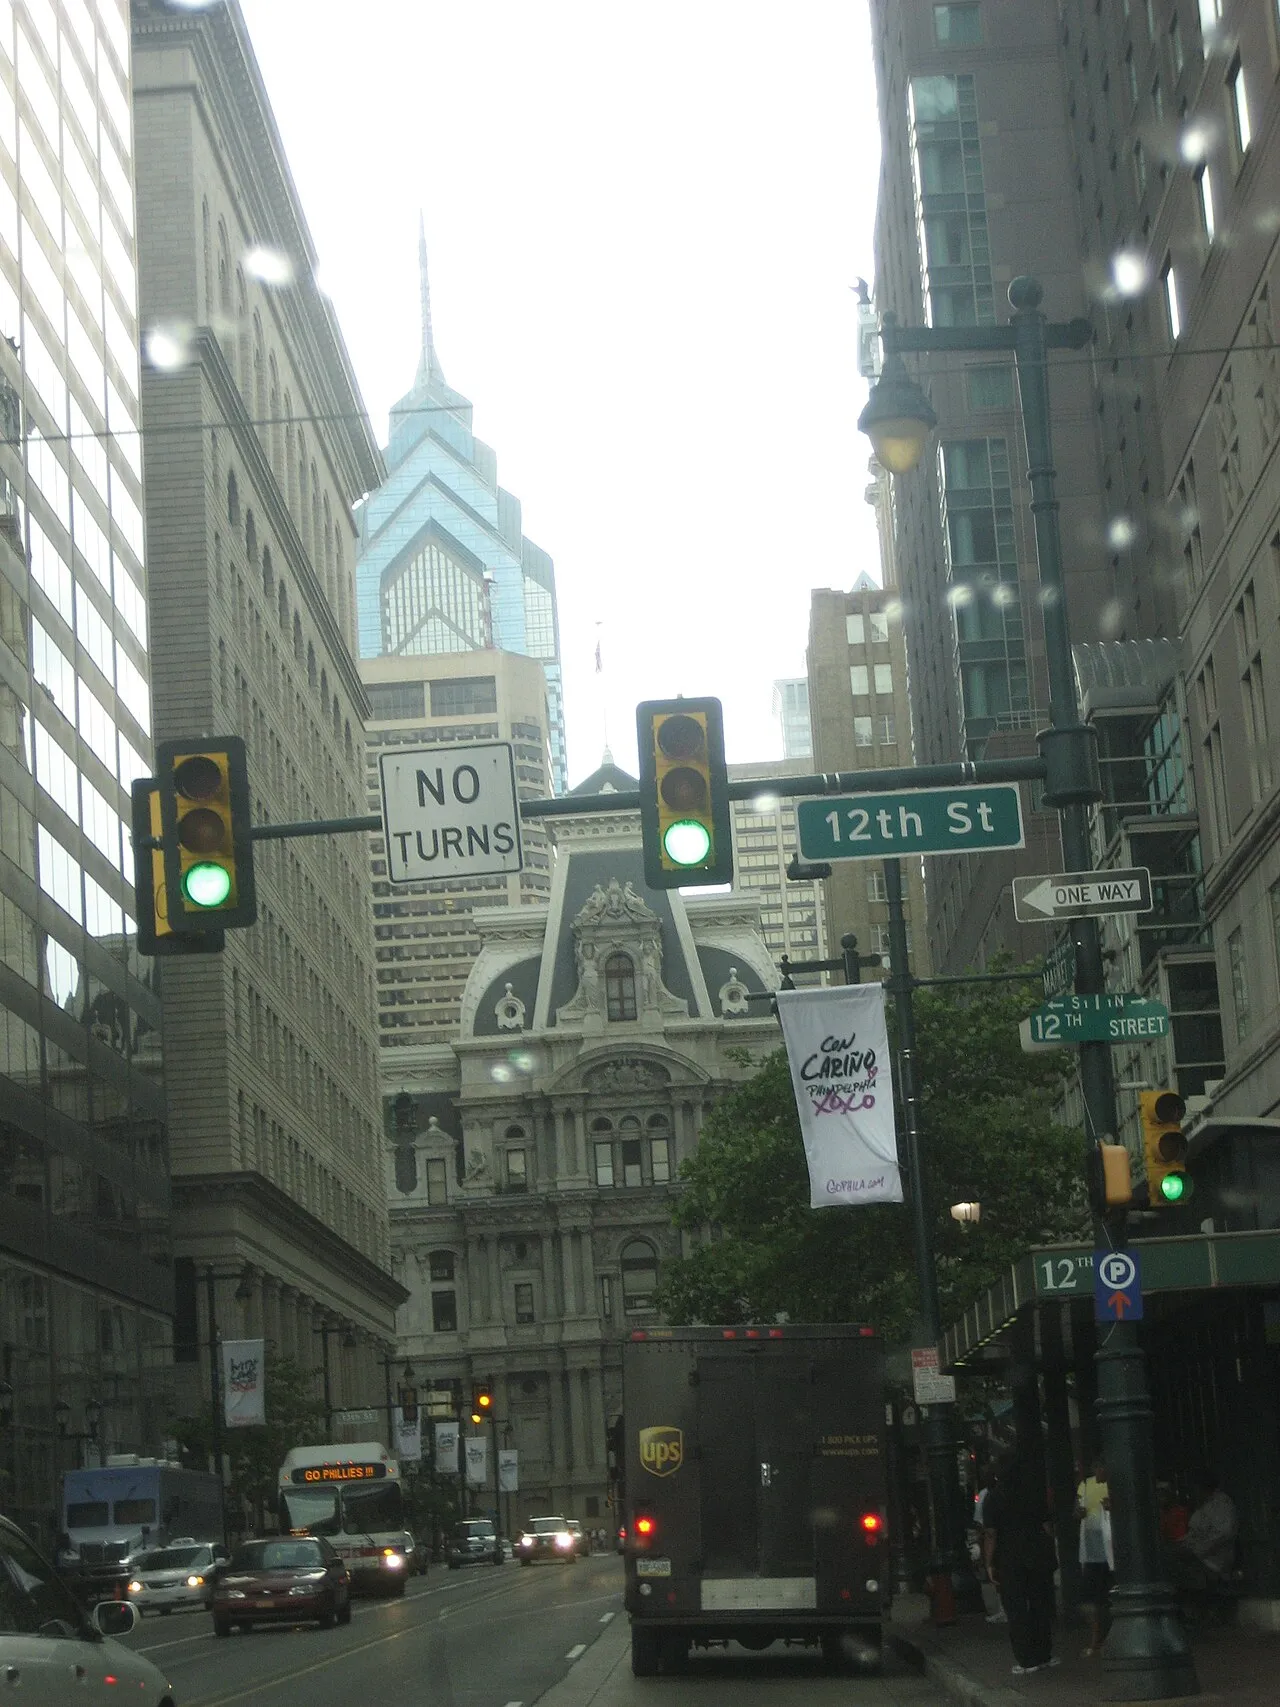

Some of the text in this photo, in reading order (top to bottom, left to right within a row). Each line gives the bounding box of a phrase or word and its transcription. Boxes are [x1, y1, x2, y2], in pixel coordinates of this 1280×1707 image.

[416, 765, 480, 807] NO
[825, 801, 994, 842] 12th St
[393, 822, 514, 863] TURNS
[1055, 882, 1134, 904] ONE WAY
[1109, 1016, 1165, 1036] STREET
[800, 1048, 876, 1080] CARIÑO
[811, 1089, 876, 1116] XOXO
[304, 1469, 321, 1481] GO
[322, 1466, 364, 1480] PHILLIES
